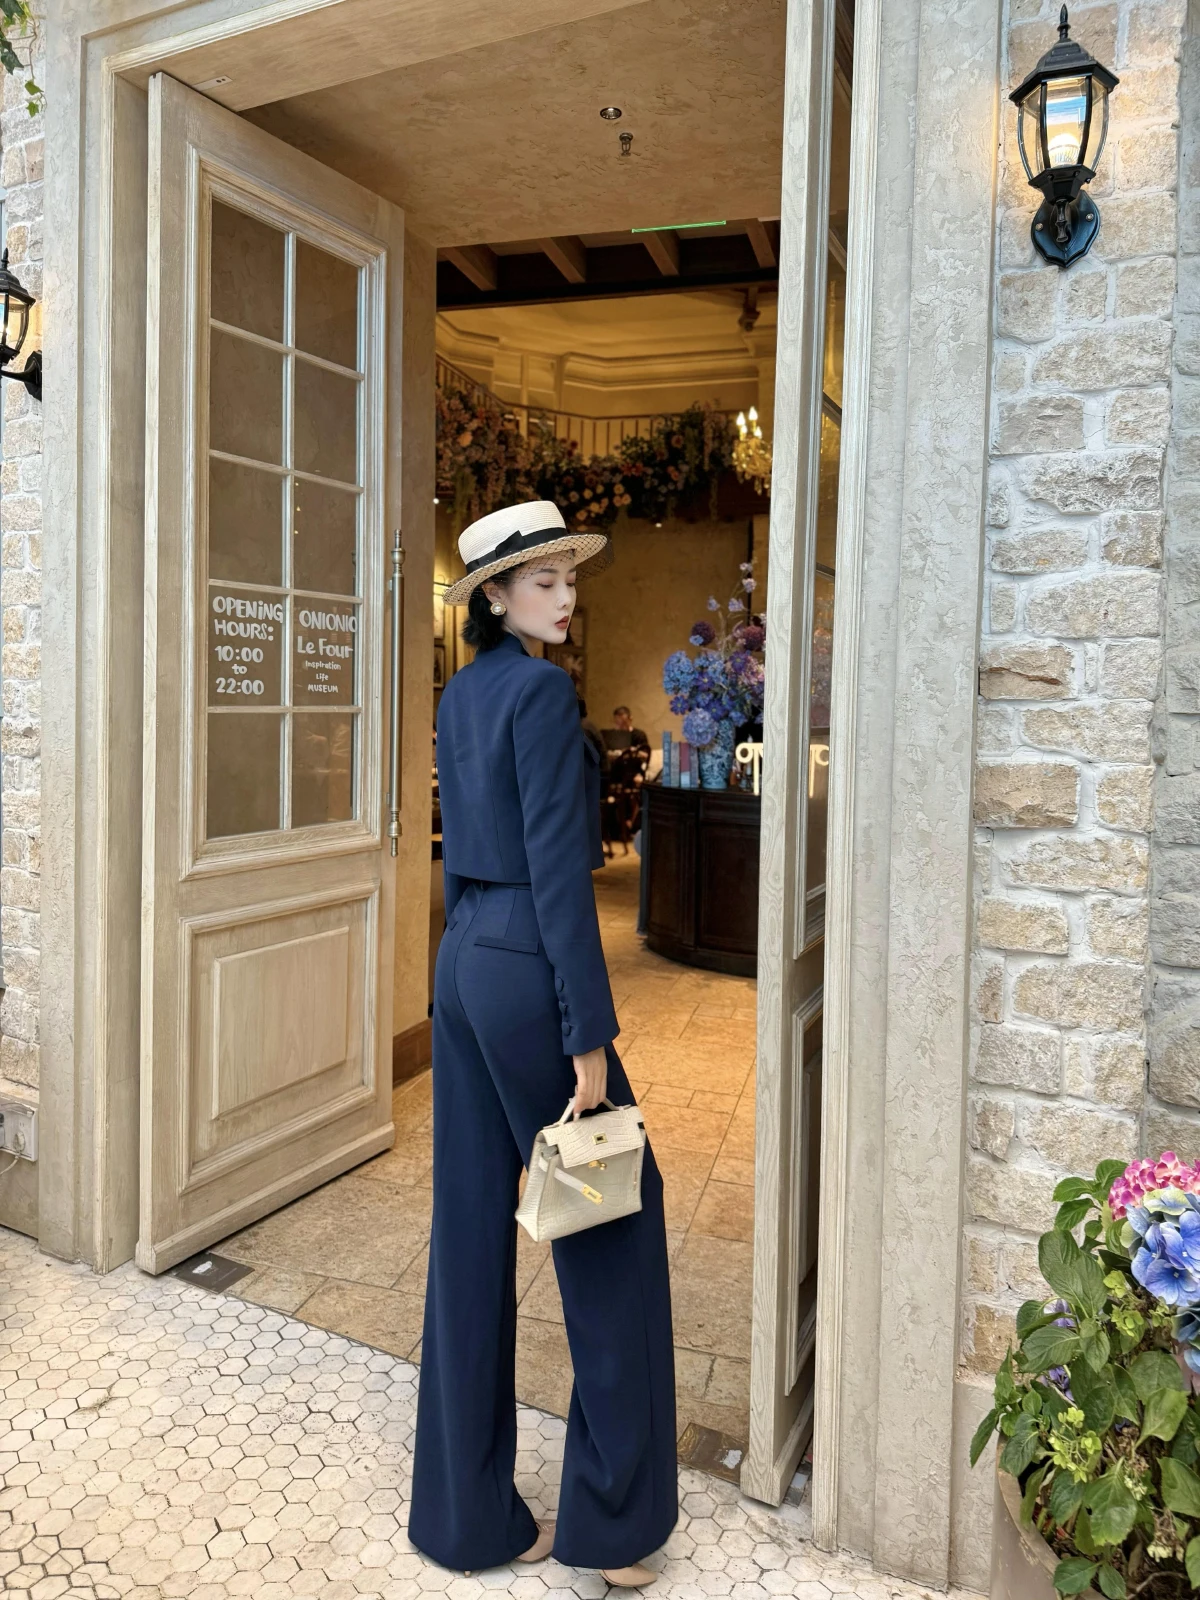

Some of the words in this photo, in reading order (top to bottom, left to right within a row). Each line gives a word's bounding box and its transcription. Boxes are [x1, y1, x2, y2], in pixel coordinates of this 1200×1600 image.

[214, 619, 274, 641] HOURS:
[214, 645, 264, 663] 10:00
[297, 636, 316, 654] Le
[318, 638, 353, 658] Four
[231, 663, 248, 675] to
[305, 660, 342, 670] Inspiration
[315, 673, 329, 682] Life
[215, 677, 265, 695] 22:00
[307, 684, 339, 693] MUSEUM
